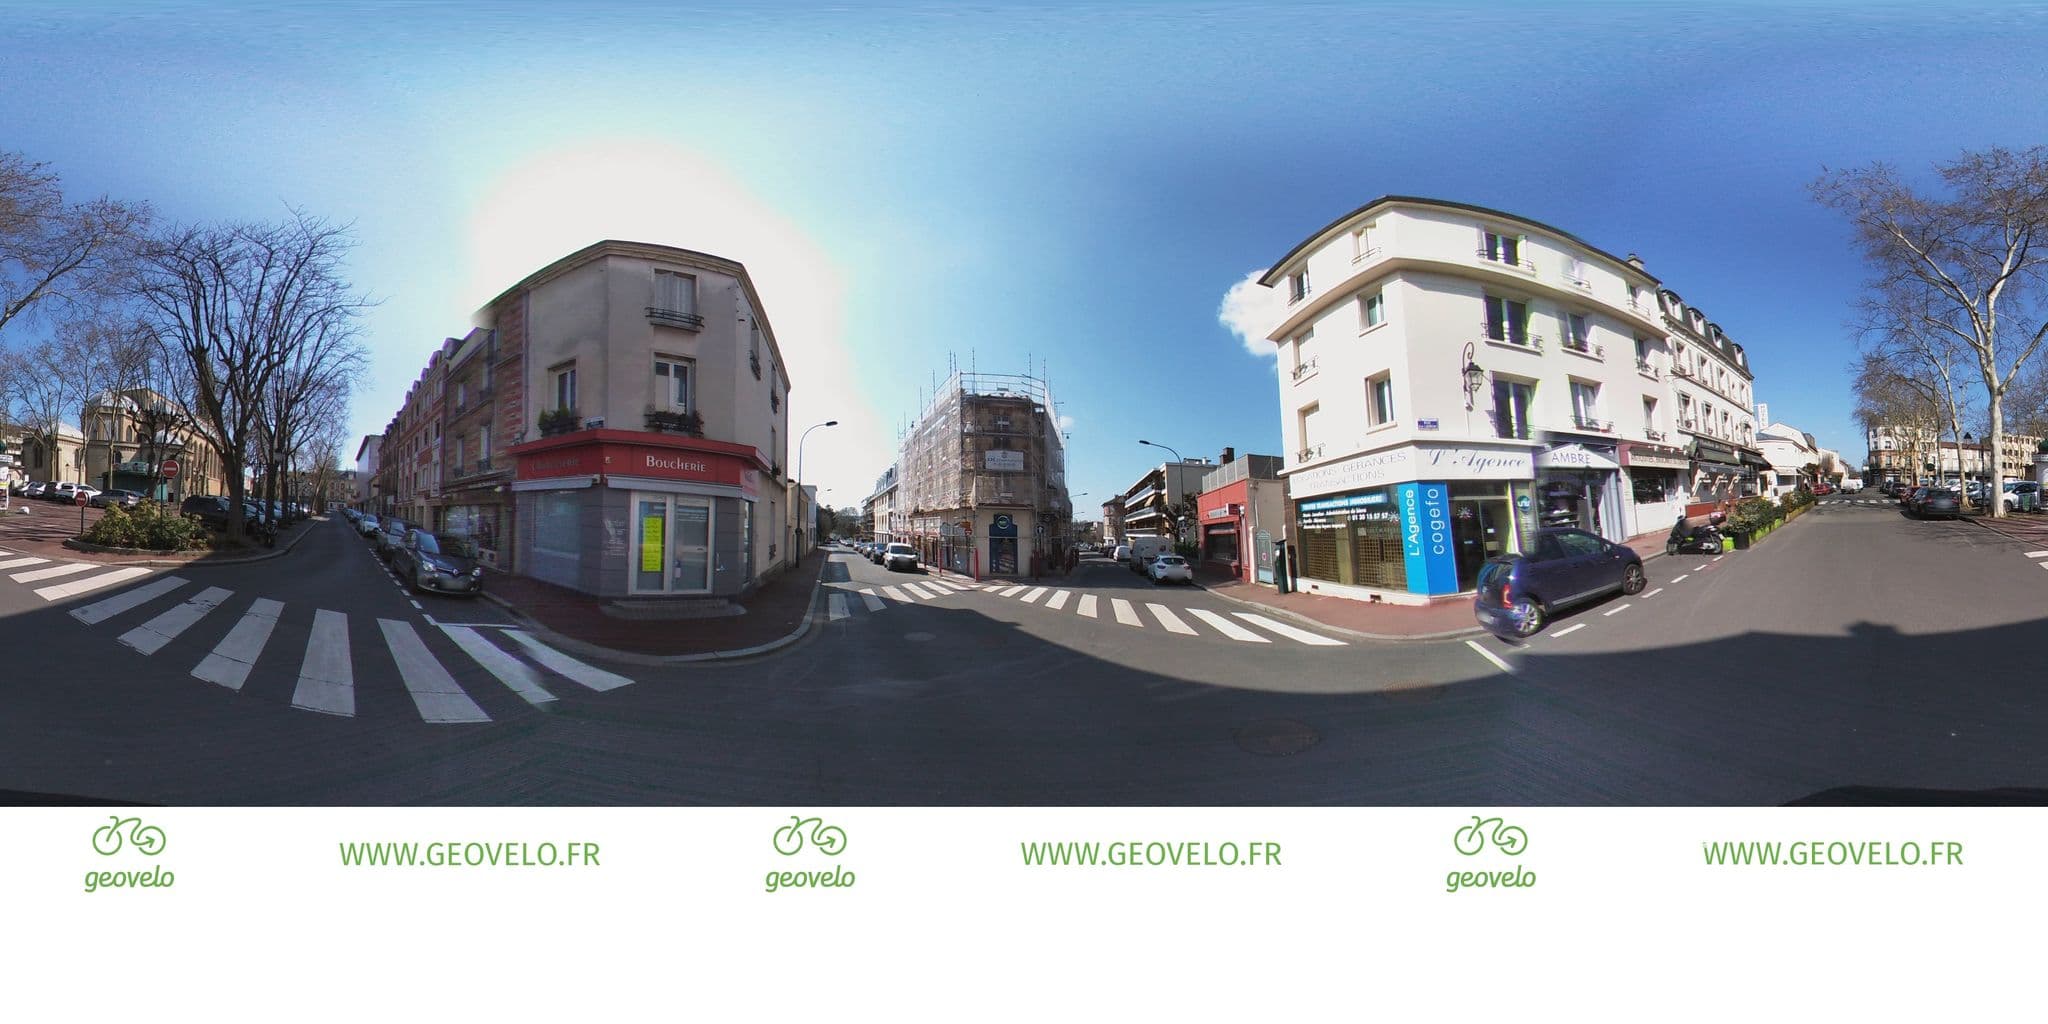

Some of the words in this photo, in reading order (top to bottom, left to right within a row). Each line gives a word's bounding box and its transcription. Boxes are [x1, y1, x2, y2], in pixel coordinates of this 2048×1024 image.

[1429, 449, 1525, 473] L'Agence
[1551, 452, 1591, 464] AMBRE
[1405, 489, 1420, 556] L'Agence
[1425, 488, 1445, 555] cogefo
